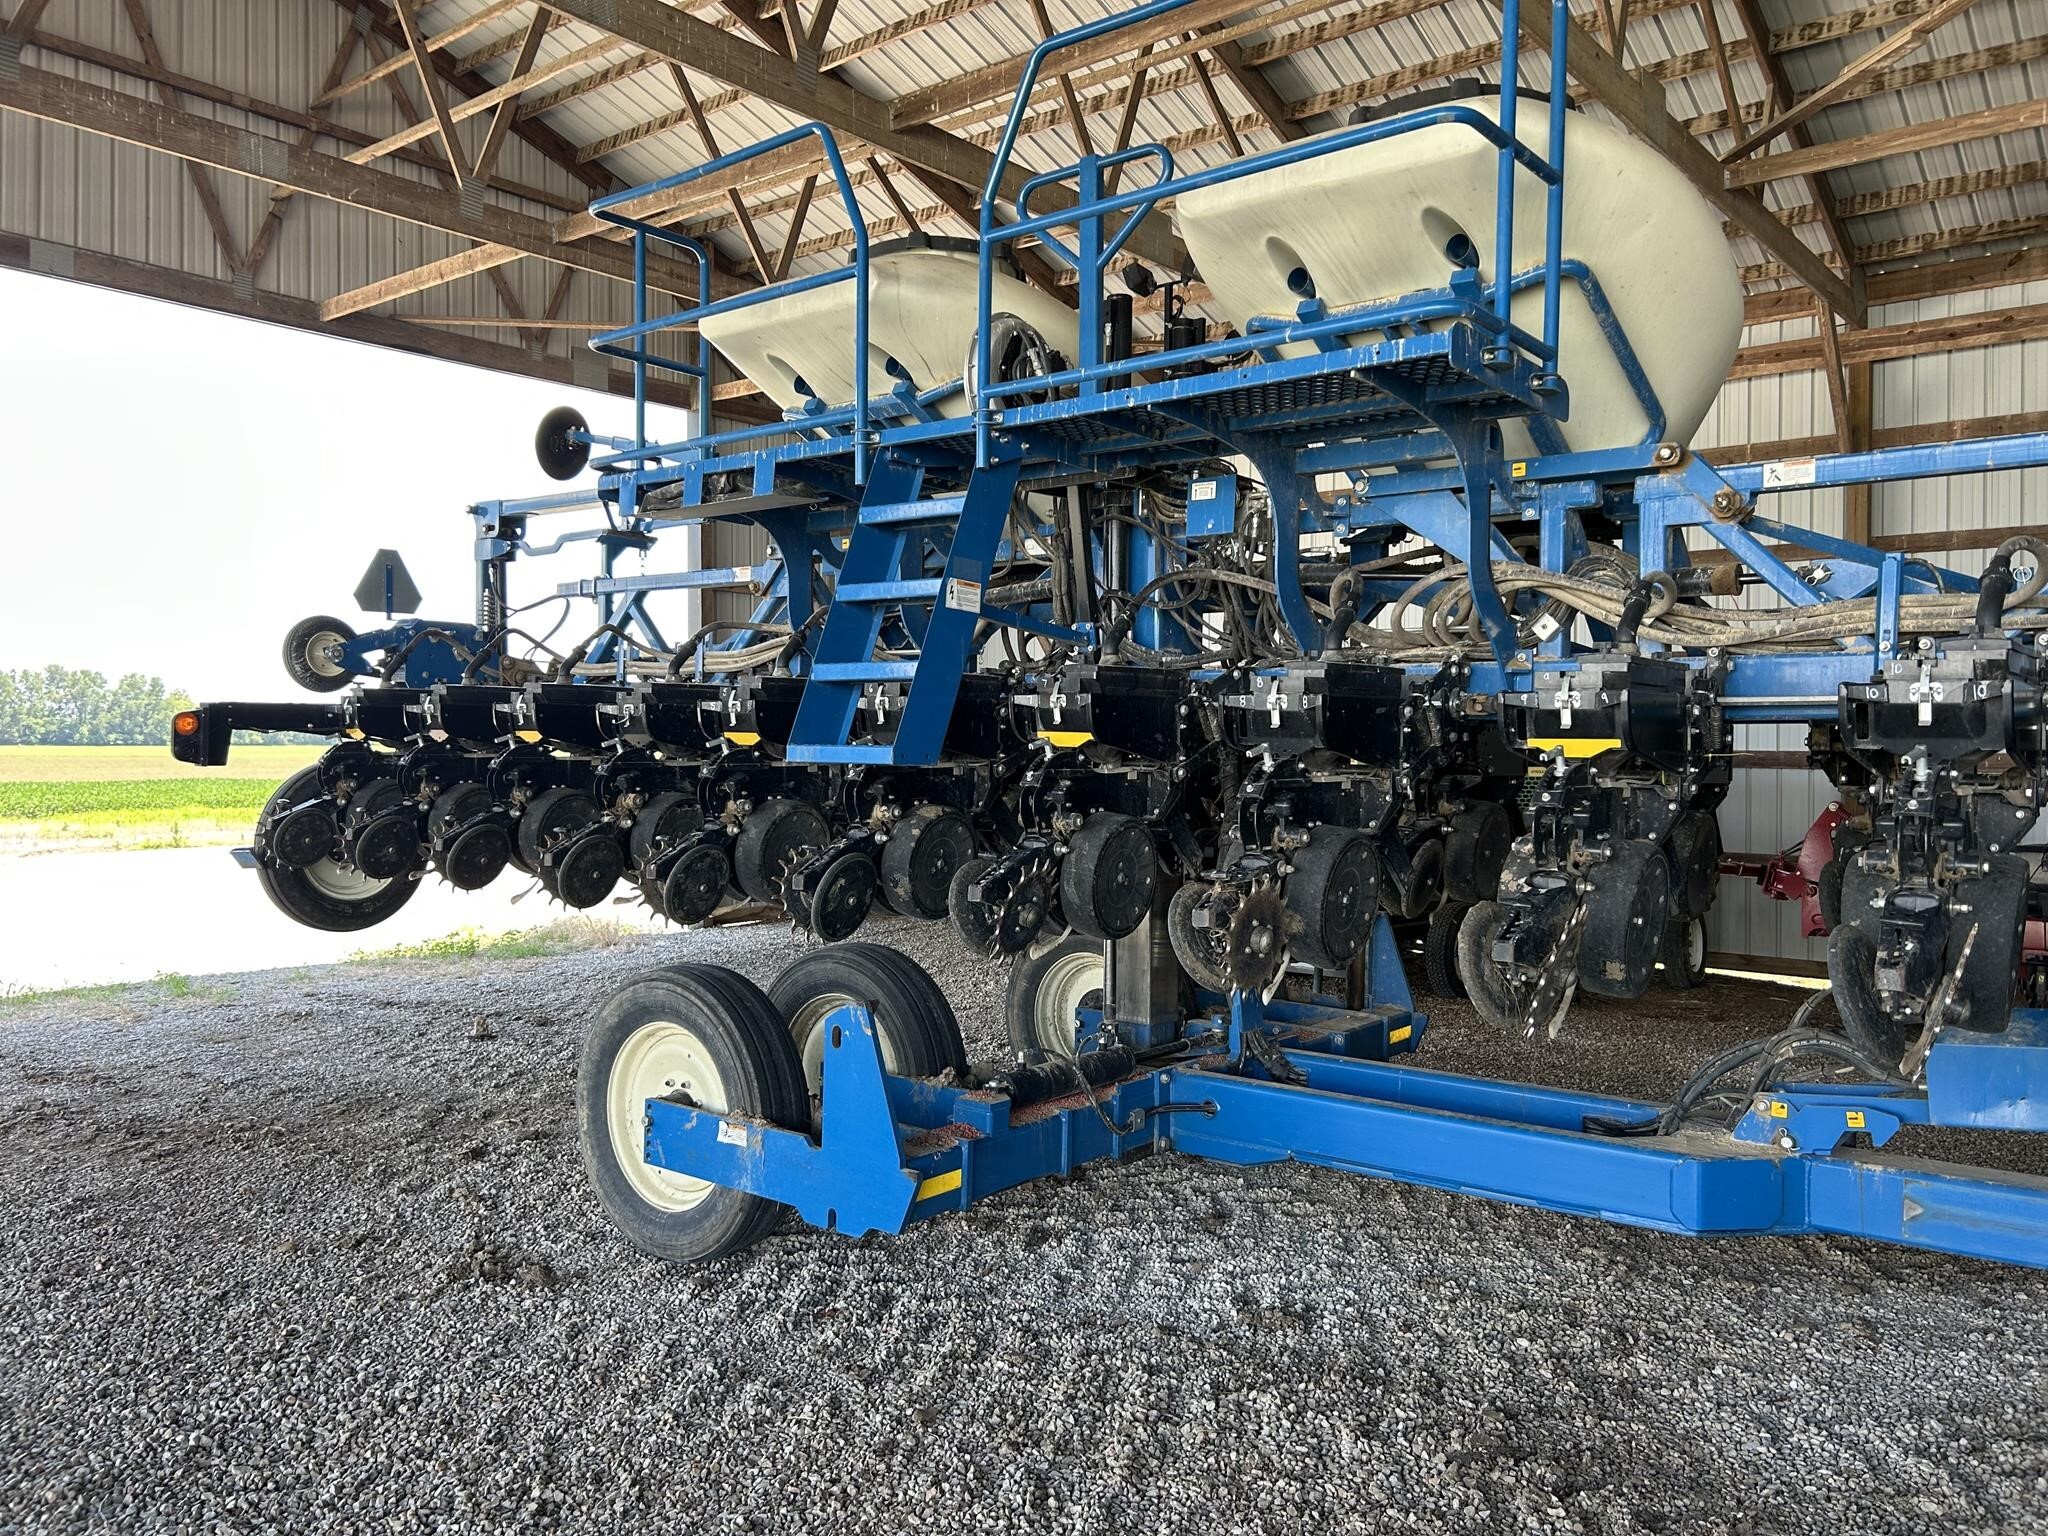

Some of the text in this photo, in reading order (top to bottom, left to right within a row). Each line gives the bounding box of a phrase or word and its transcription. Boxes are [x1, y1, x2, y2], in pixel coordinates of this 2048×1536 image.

[1890, 662, 1903, 676] 10
[868, 683, 874, 693] 6
[1041, 678, 1048, 688] 7
[1256, 676, 1264, 688] 8
[722, 687, 728, 697] 5
[1865, 686, 1879, 699] 10
[1973, 683, 1987, 700] 10
[1239, 694, 1246, 708] 8
[1302, 694, 1308, 709] 8
[1520, 693, 1527, 705] 9
[1600, 692, 1609, 704] 9
